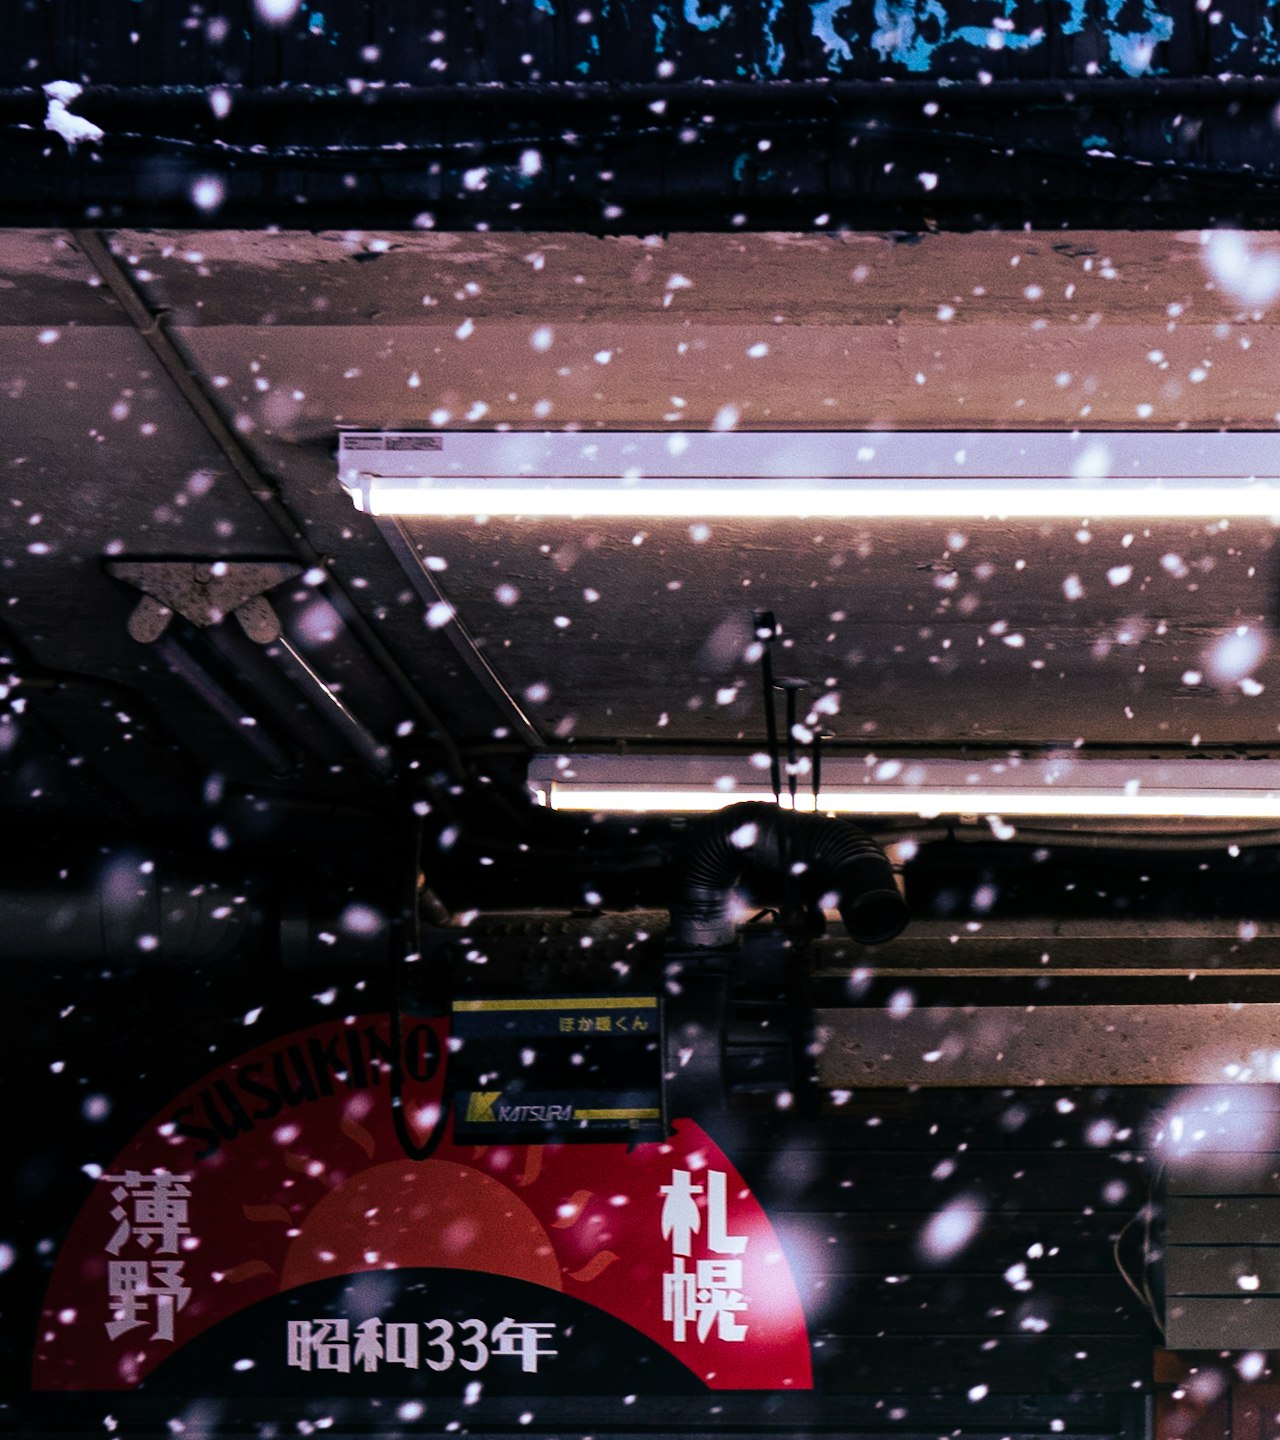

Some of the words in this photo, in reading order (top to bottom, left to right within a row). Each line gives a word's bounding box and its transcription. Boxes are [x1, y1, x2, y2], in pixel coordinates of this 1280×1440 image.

[171, 1022, 441, 1162] SUSUKINO
[497, 1104, 573, 1122] KATSURA
[104, 1169, 193, 1343] 薄野
[660, 1168, 749, 1344] 札幌
[287, 1315, 558, 1374] 昭和33年
